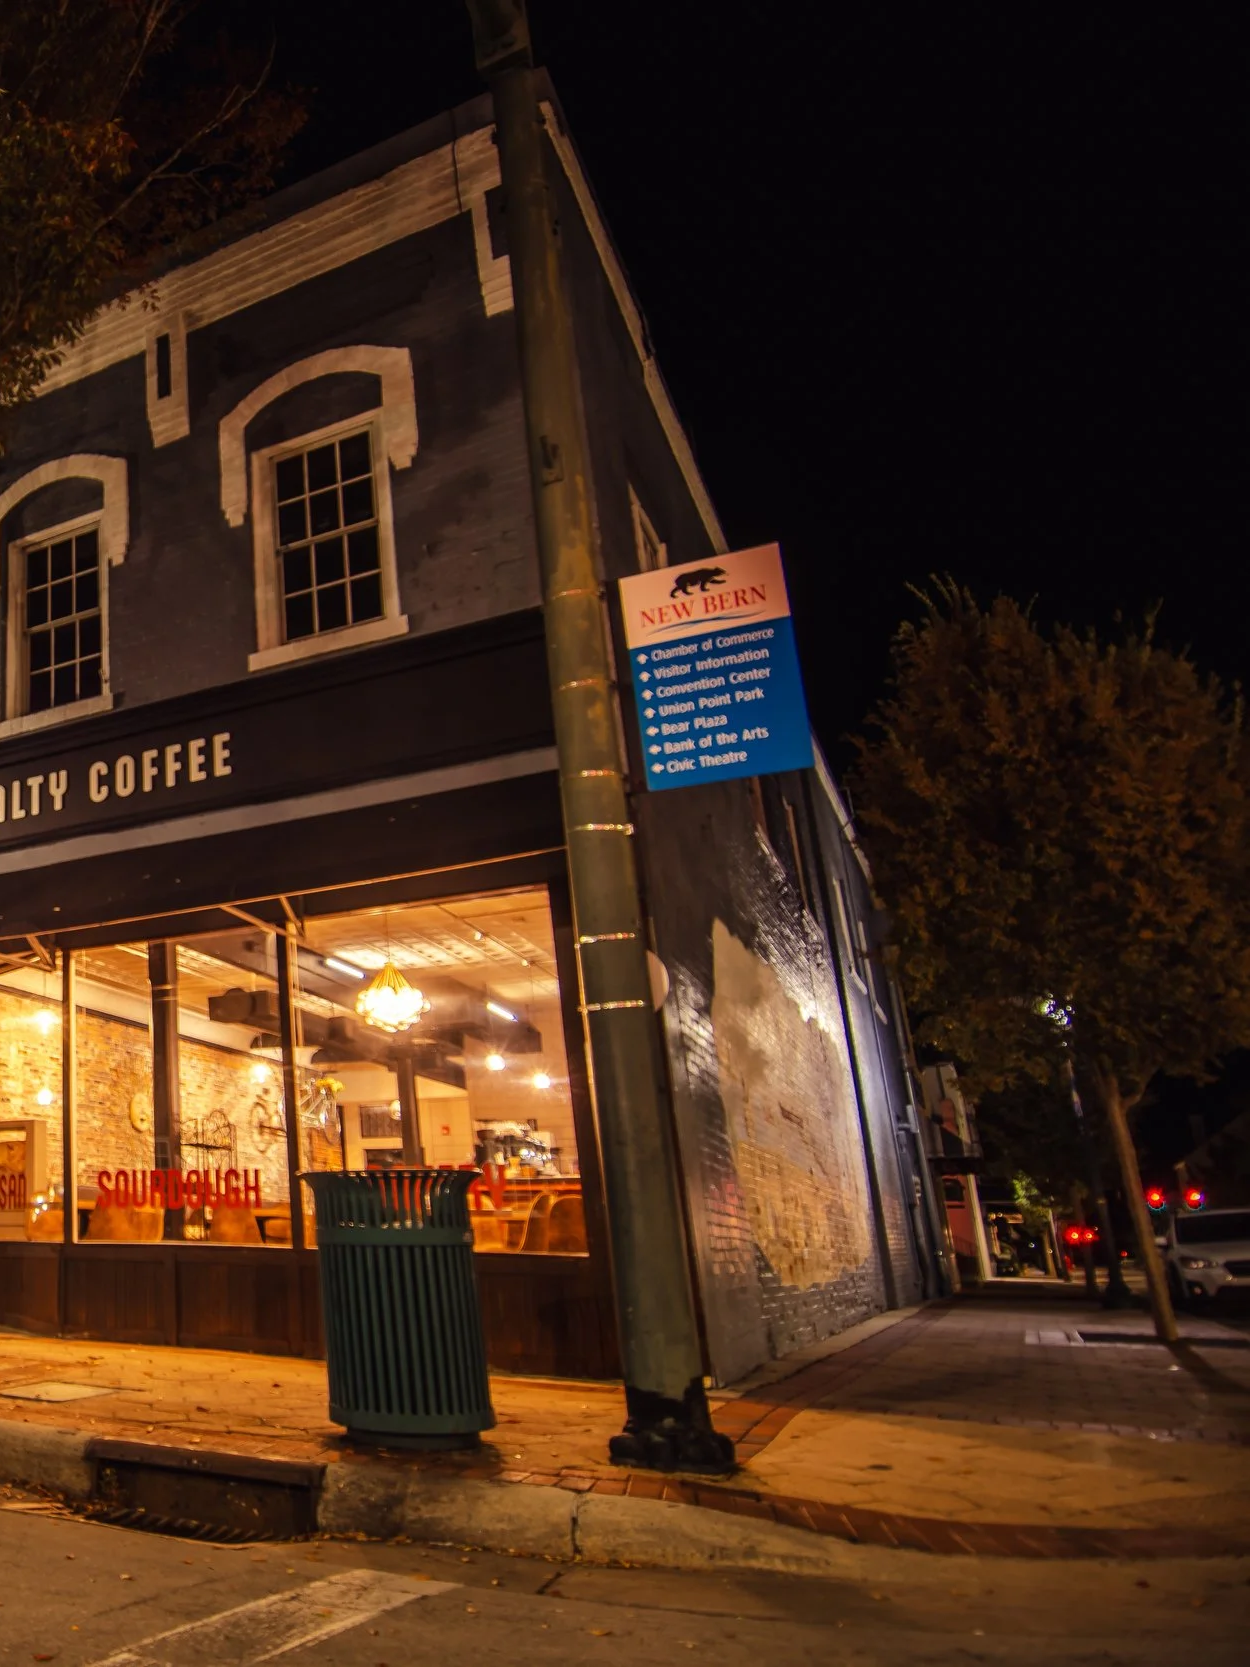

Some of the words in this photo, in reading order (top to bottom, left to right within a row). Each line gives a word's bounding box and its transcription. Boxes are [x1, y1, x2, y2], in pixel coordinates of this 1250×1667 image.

[640, 601, 695, 628] NEW
[703, 584, 767, 614] BERN
[651, 644, 698, 662] Chamber
[702, 639, 713, 650] of
[716, 628, 774, 649] Commerce
[654, 664, 691, 680] Visitor
[697, 647, 769, 672] Information
[656, 675, 725, 698] Convention
[730, 666, 771, 684] Center
[659, 700, 695, 716] Union
[700, 693, 731, 709] Point
[736, 687, 765, 702] Park
[662, 720, 689, 736] Bear
[694, 714, 728, 729] Plaza
[664, 738, 695, 754] Bank
[699, 735, 713, 749] of
[716, 731, 738, 745] the
[743, 726, 770, 742] Arts
[88, 732, 232, 803] COFFEE
[667, 758, 696, 774] Civic
[700, 750, 748, 767] Theatre
[97, 1168, 262, 1210] SOURDOUGH
